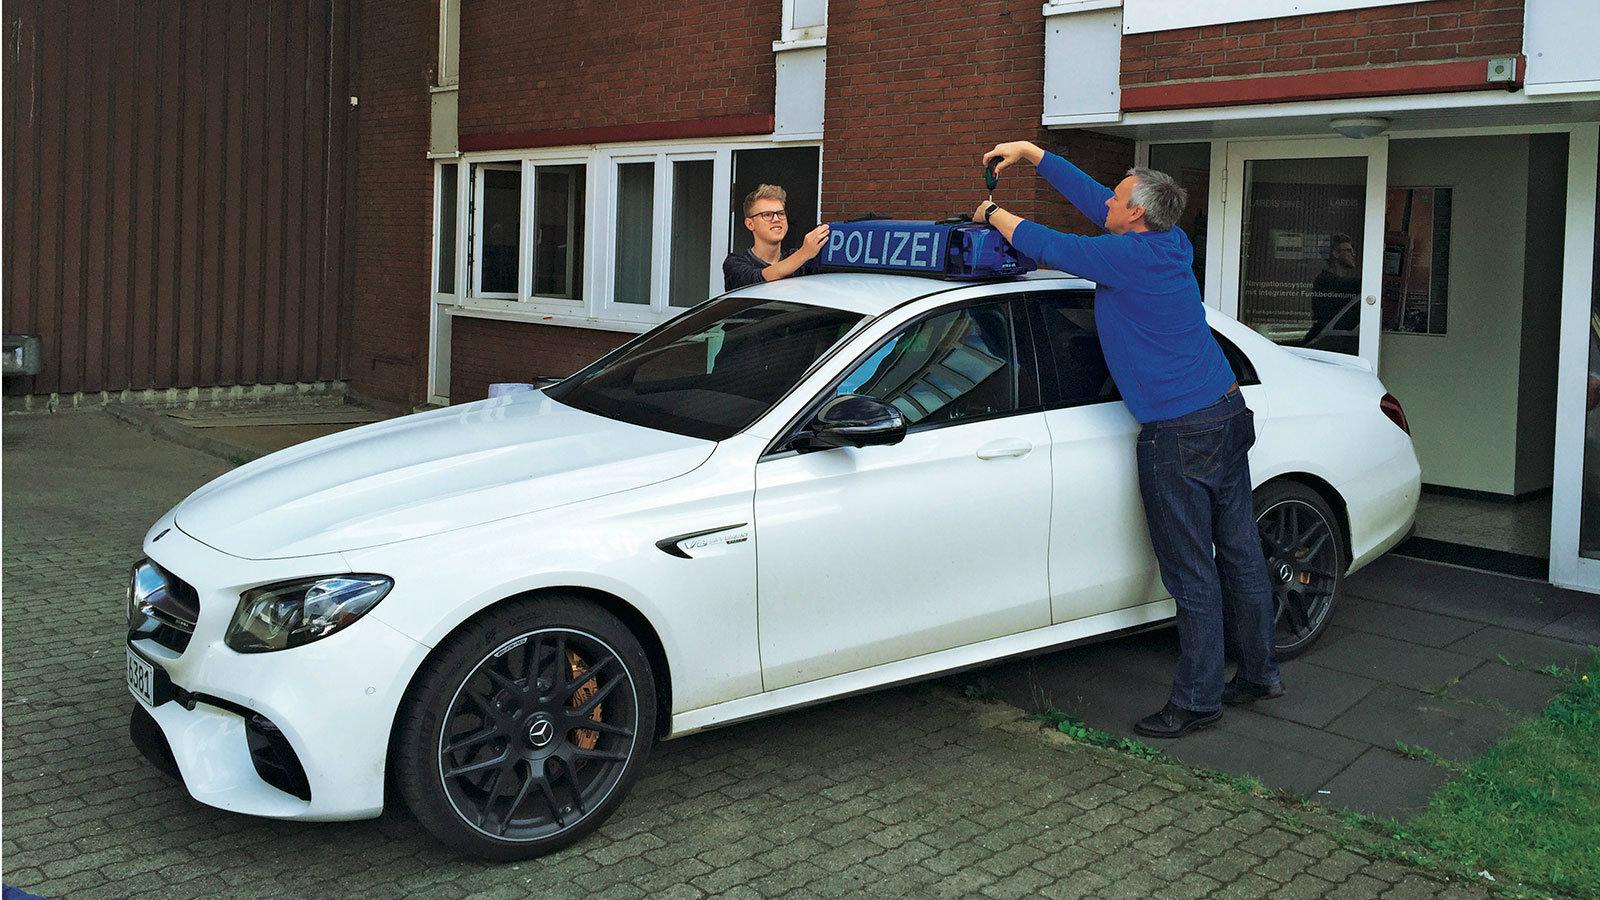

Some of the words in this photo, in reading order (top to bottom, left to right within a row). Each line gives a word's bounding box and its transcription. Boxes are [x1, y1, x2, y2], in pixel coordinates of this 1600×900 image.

[827, 230, 940, 268] POLIZEI
[1245, 280, 1313, 289] Navigationssystem
[1258, 289, 1300, 298] integrierter
[128, 656, 151, 699] 6381
